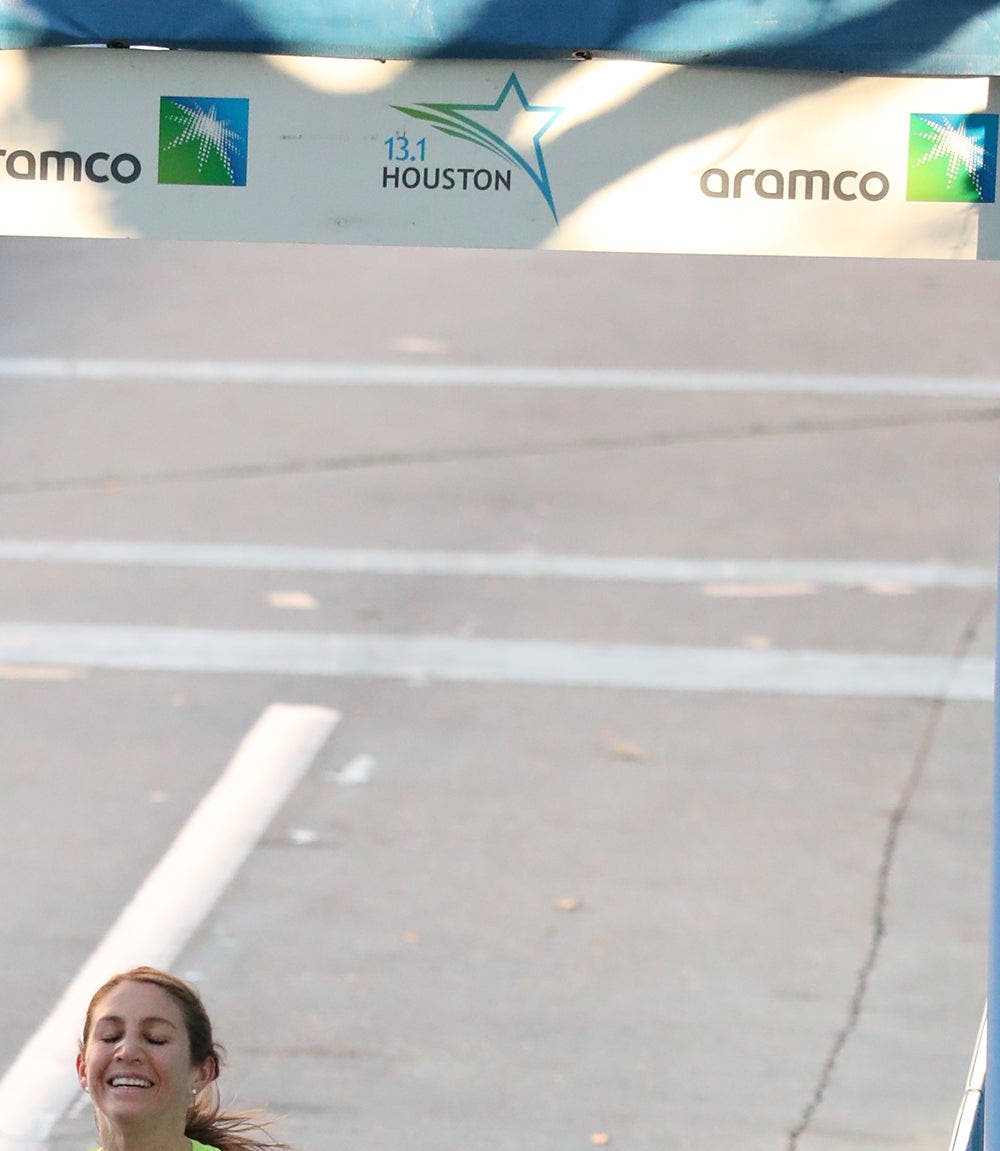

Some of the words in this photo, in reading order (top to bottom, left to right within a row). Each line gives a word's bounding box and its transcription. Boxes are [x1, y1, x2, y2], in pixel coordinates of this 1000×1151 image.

[384, 136, 426, 162] 13.1
[382, 166, 512, 192] HOUSTON
[700, 167, 890, 202] aramco
